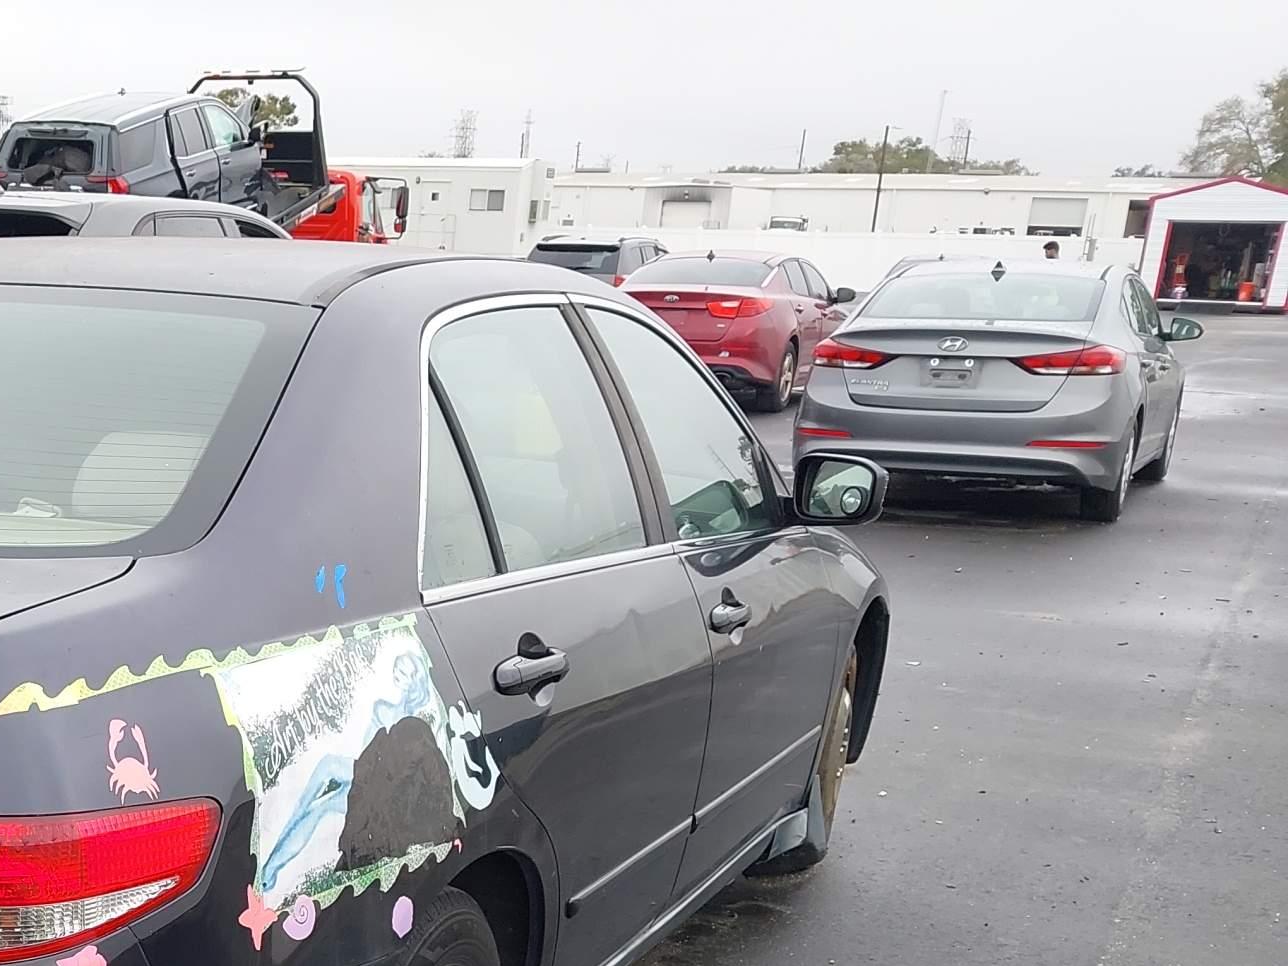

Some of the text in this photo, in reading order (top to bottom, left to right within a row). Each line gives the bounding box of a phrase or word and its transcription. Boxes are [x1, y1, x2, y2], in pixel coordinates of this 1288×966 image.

[265, 720, 304, 778] Art
[293, 702, 321, 736] by
[313, 672, 341, 718] the
